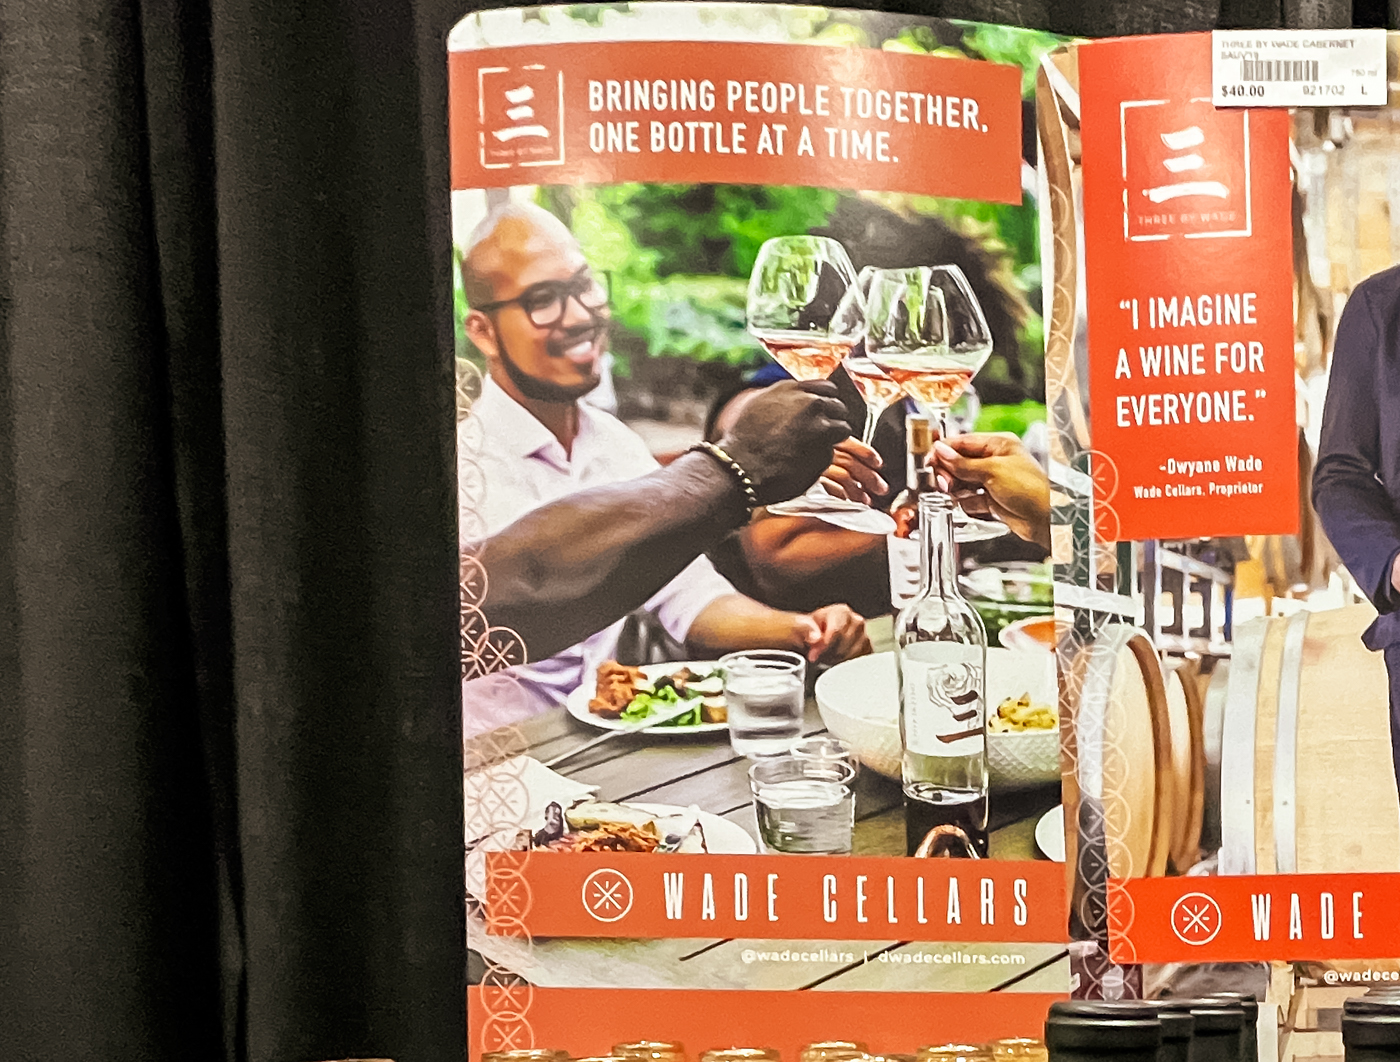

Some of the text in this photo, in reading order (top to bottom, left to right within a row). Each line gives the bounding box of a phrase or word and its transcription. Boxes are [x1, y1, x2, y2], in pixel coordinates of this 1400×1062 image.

[1302, 39, 1355, 48] CABERNET
[588, 78, 989, 133] BRINGING PEOPLE TOGETHER,
[1221, 85, 1265, 97] $40.00
[589, 121, 899, 163] ONE BOTTLE AT A TIME.
[1149, 293, 1257, 329] IMAGINE
[1115, 341, 1265, 379] A WINE FOR
[1225, 455, 1263, 473] Wade
[1134, 485, 1162, 499] Wade
[1209, 481, 1263, 497] Proprietor
[663, 871, 1029, 926] WADE CELLARS
[1251, 891, 1364, 942] WADE
[741, 948, 854, 965] @wadecellars
[878, 949, 1026, 966] dwadecellars.com
